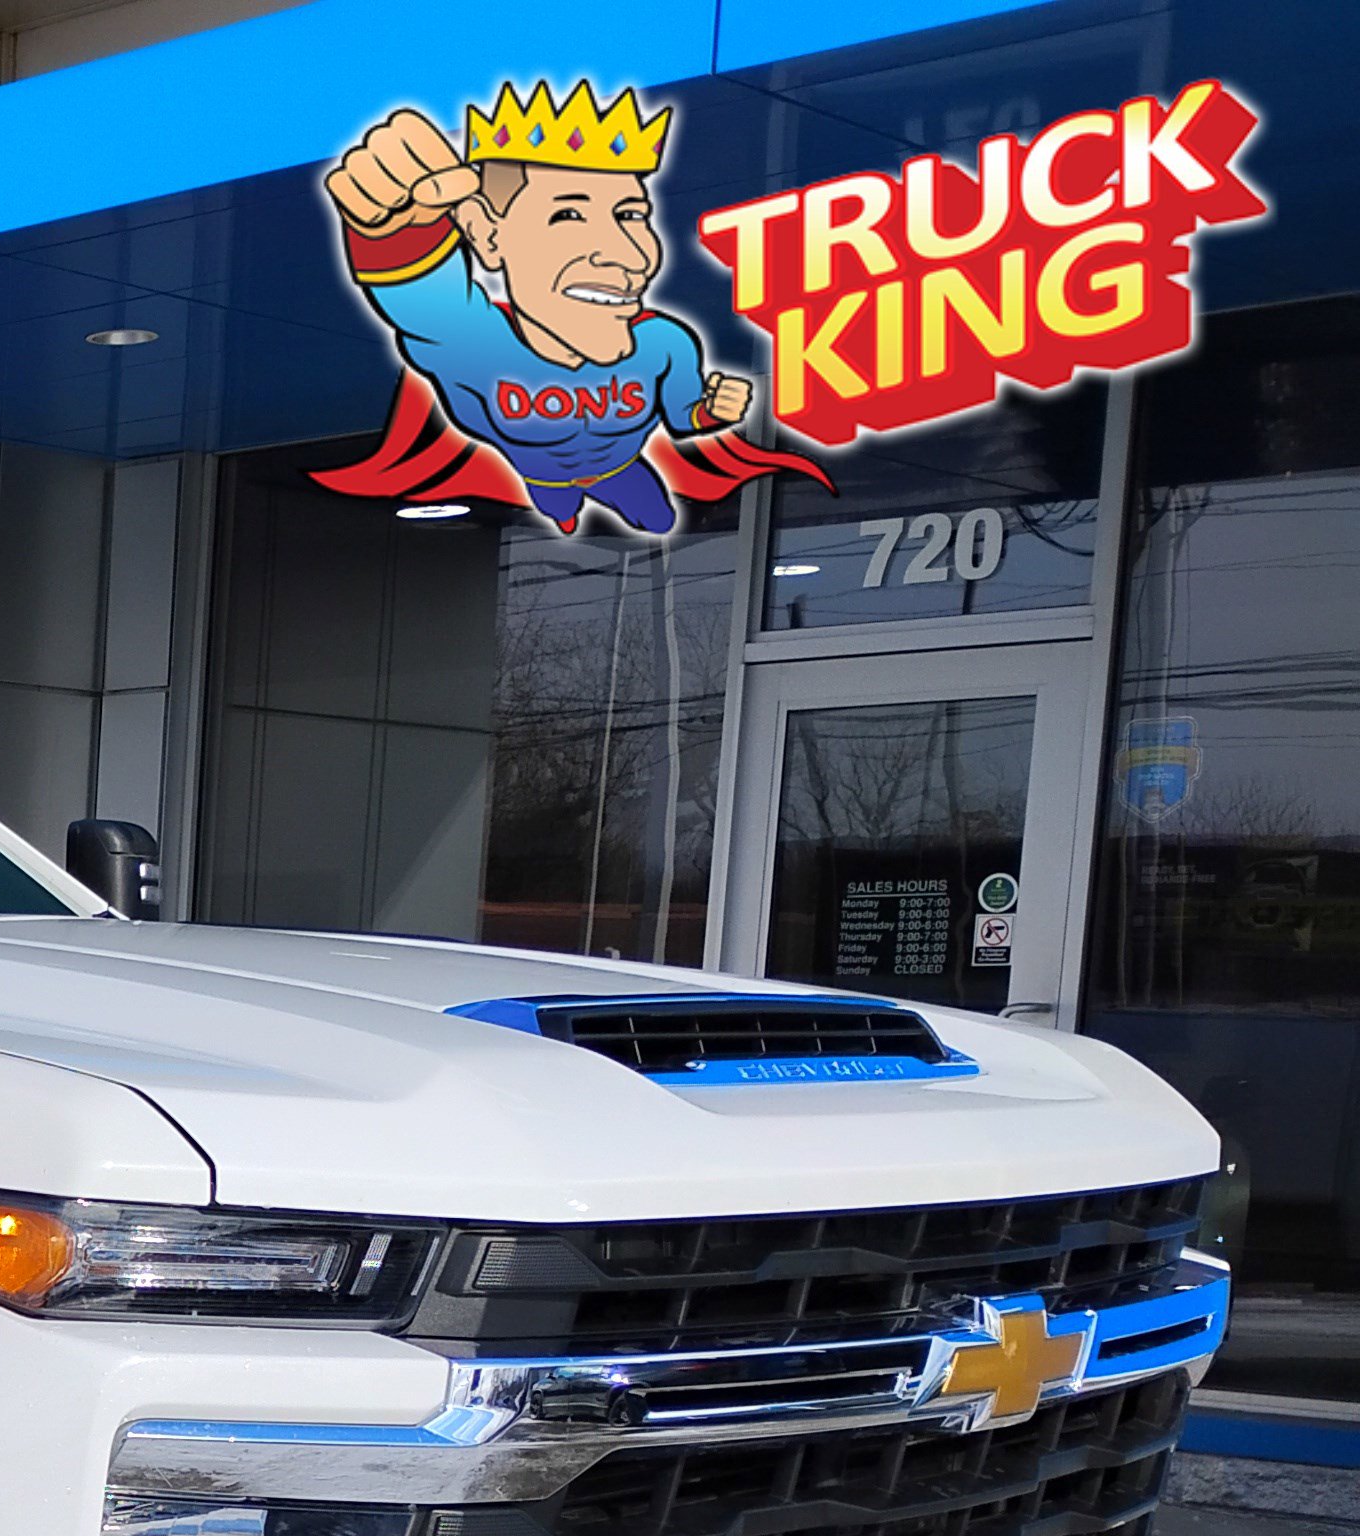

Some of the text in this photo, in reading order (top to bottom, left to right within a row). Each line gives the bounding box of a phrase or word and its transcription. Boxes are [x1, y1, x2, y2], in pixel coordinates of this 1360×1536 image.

[860, 507, 1003, 588] 720
[847, 880, 948, 894] SALES HOURS
[842, 898, 950, 909] Monday 9:00-7:00
[841, 911, 879, 920] Tuesday
[840, 921, 895, 931] Wednesday
[840, 931, 948, 942] Thursday 9:00-7:00
[838, 943, 947, 954] Friday 9:00-6:00
[837, 955, 879, 965] Saturday
[836, 964, 943, 976] Sunday CLOSED
